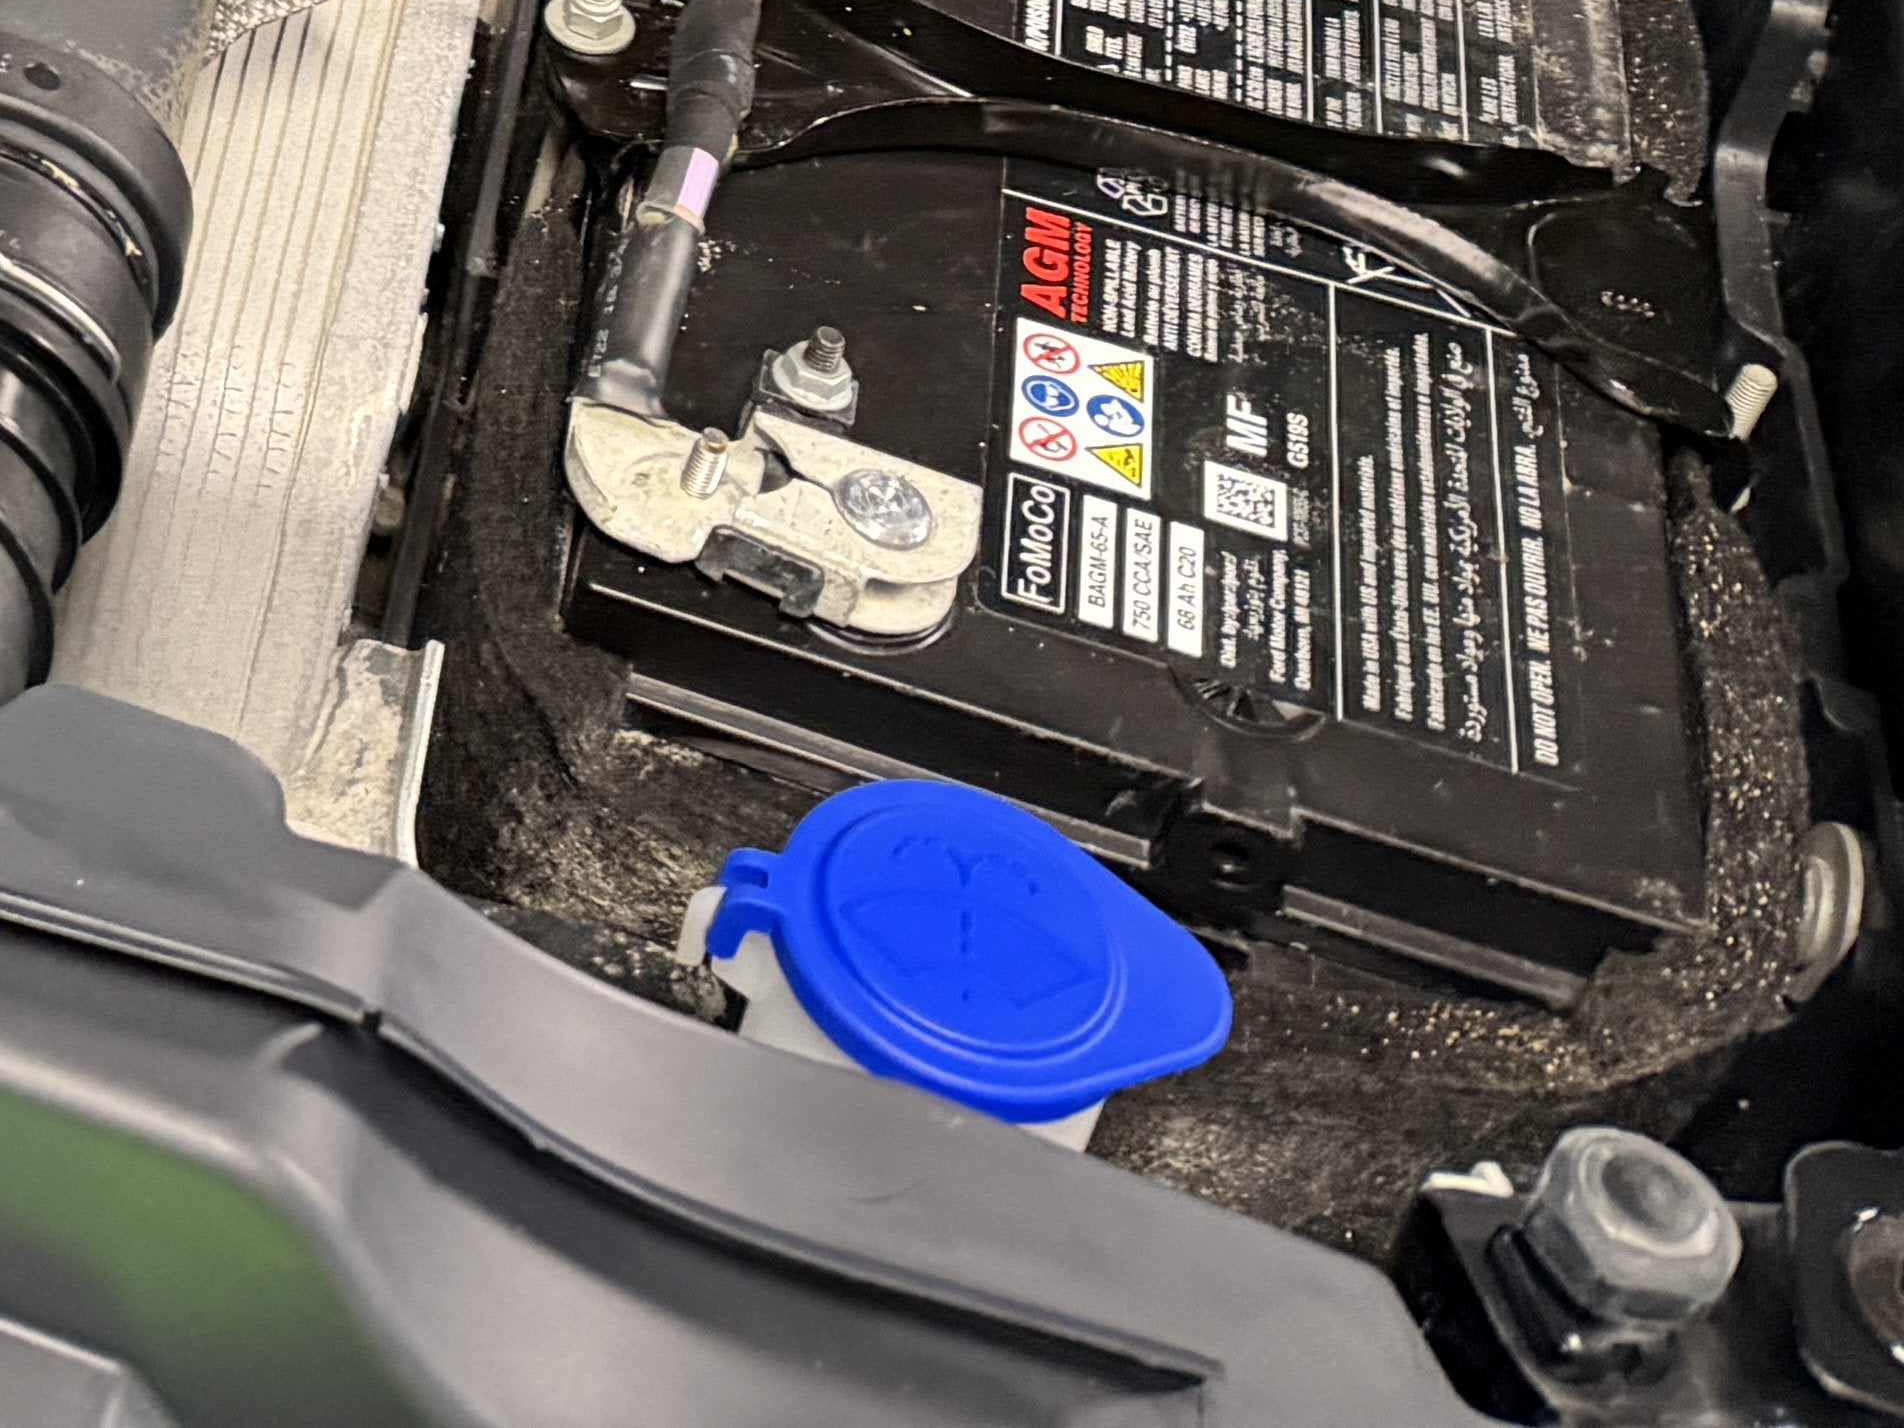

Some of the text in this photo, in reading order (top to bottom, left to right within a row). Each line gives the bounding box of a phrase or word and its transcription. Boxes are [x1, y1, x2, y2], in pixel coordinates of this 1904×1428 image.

[1021, 208, 1070, 316] AGM
[1071, 223, 1092, 322] TECHNOLOGY
[1102, 239, 1121, 332] NON-SPILLABLE
[1226, 395, 1267, 456] MF
[1017, 480, 1055, 604] FoMoCo
[1087, 516, 1109, 608] BAGM-65-A
[1131, 518, 1153, 629] 750 CCA/SAE
[1177, 546, 1196, 579] C20
[1177, 583, 1195, 607] Ah
[1514, 444, 1559, 765] DO NOT OPEN. NE PAS OUVRIR. NO LA ABRA.
